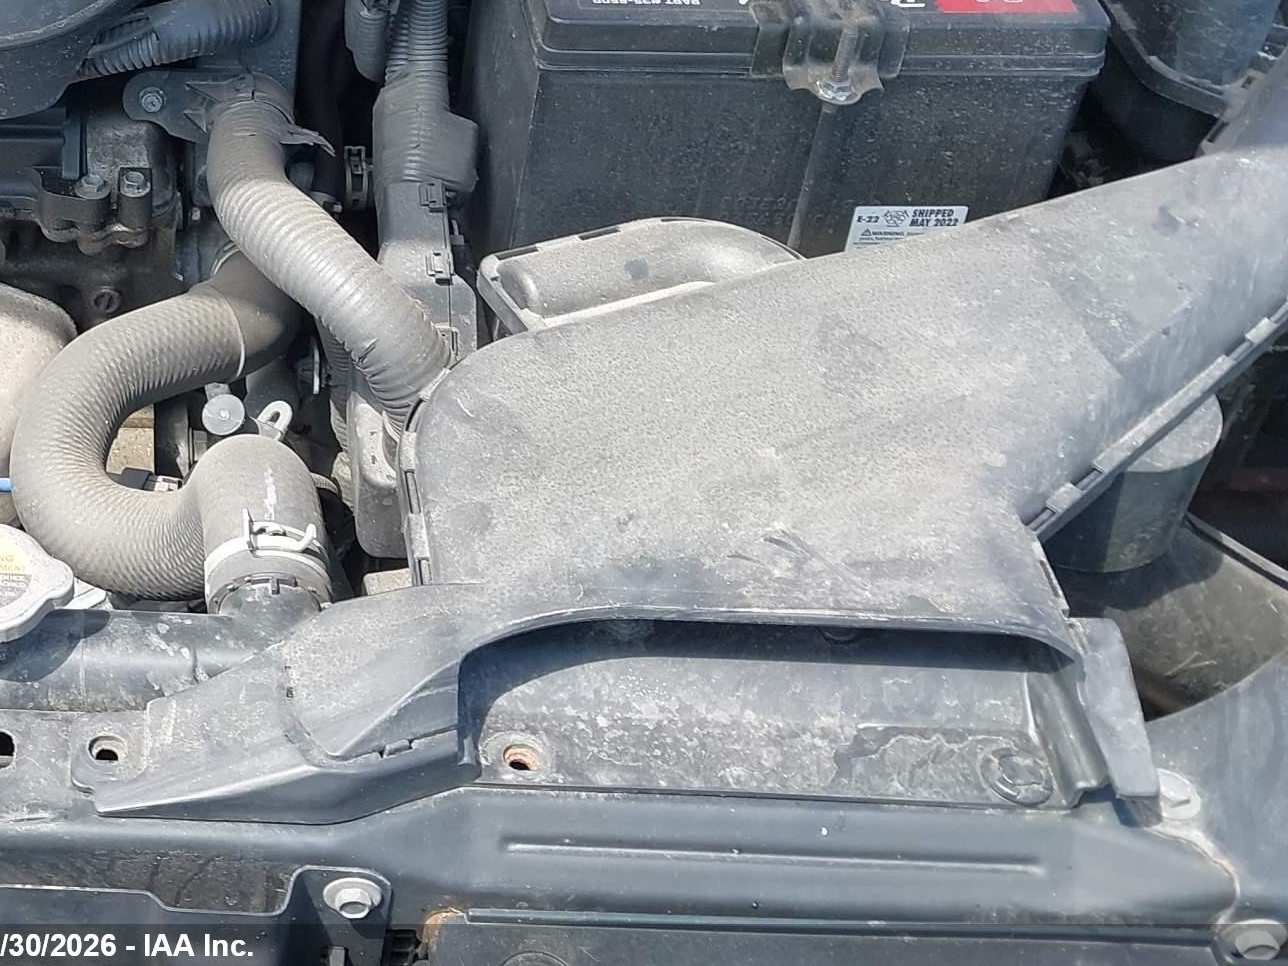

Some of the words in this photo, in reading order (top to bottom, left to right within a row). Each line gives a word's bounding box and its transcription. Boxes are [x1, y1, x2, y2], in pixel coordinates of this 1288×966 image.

[912, 209, 955, 218] SHIPPED
[857, 215, 880, 223] E-22
[909, 218, 931, 227] MAY
[931, 218, 959, 227] 2022
